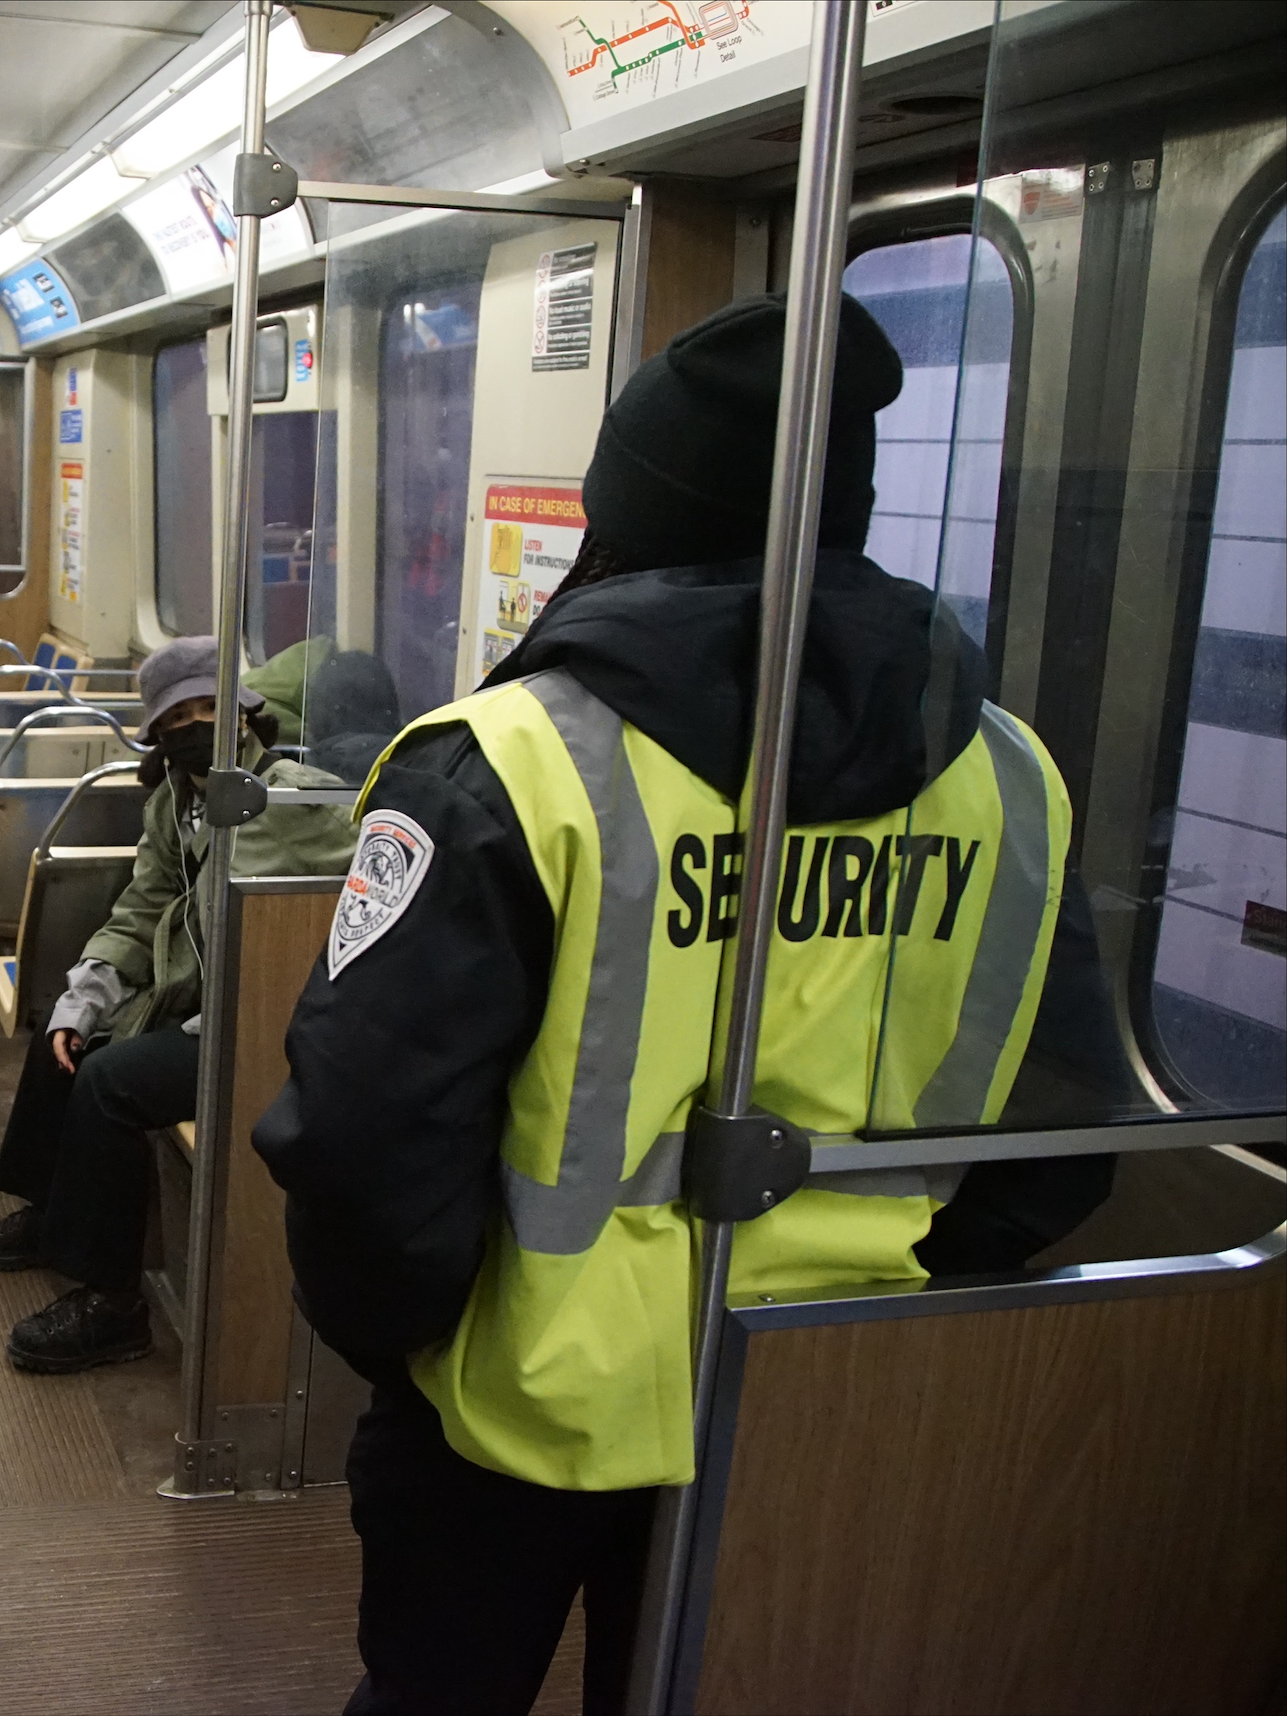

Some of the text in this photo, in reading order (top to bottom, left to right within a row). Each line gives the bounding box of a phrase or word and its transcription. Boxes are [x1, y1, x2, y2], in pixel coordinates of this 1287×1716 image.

[716, 35, 742, 50] See Loop
[720, 49, 736, 62] Detail
[489, 496, 498, 510] IN
[499, 496, 522, 513] CASE
[523, 498, 535, 514] OF
[525, 539, 543, 551] LISTEN
[524, 553, 534, 565] FOR
[391, 850, 402, 880] TRUST
[667, 833, 981, 948] SEURITY
